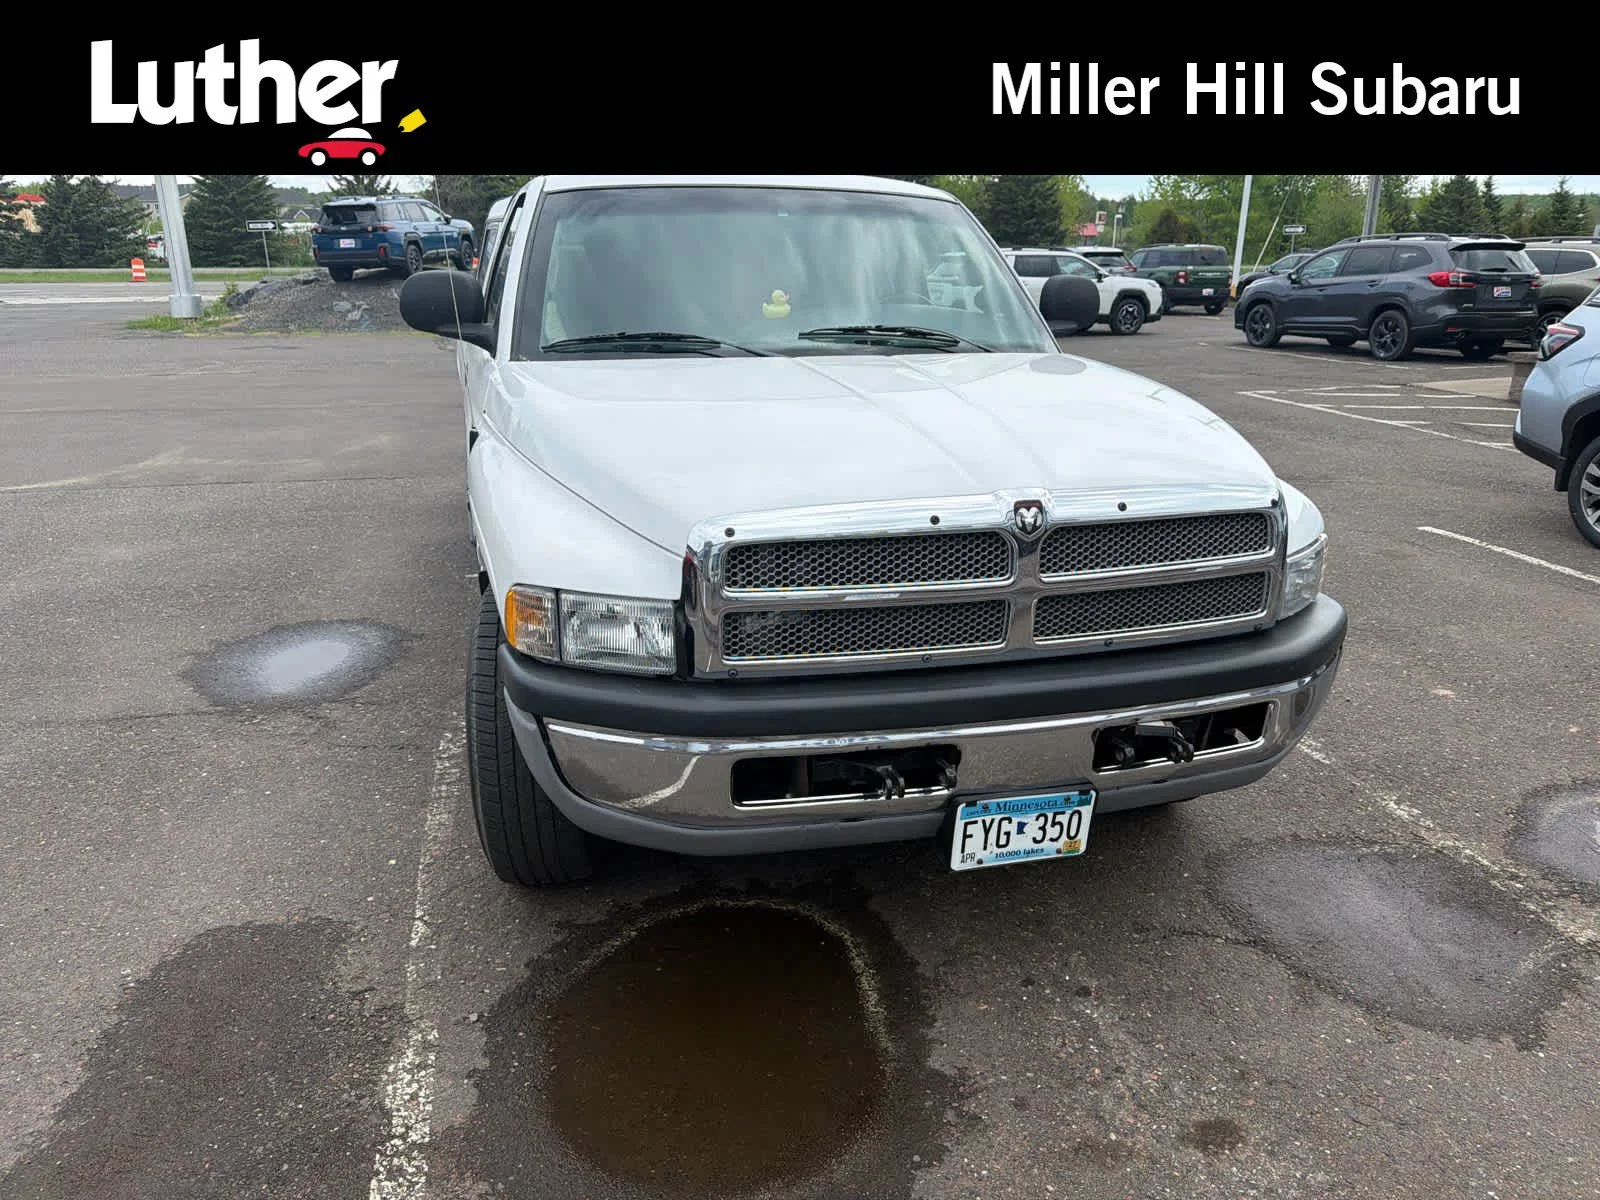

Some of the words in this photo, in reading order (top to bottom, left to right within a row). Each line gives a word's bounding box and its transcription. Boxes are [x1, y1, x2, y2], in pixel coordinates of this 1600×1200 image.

[995, 799, 1058, 812] Minnesota
[961, 816, 1012, 854] FYG
[1032, 809, 1082, 844] 350
[1023, 847, 1044, 856] lakes
[960, 852, 975, 864] APR
